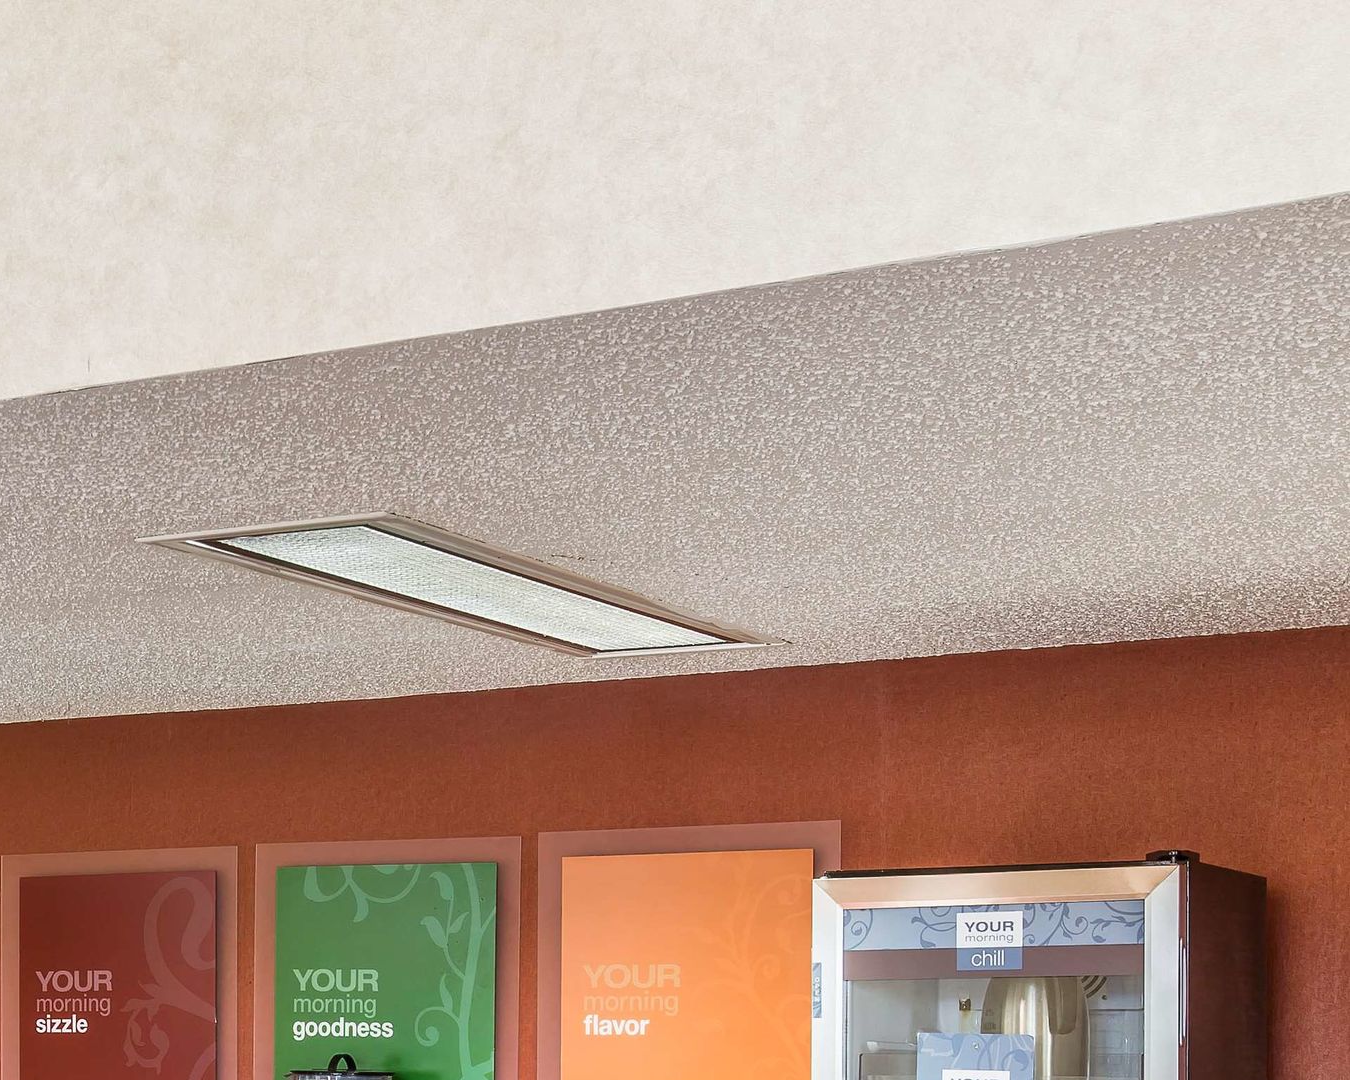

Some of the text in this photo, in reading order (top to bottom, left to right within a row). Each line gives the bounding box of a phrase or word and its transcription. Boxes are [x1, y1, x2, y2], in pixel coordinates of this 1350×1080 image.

[964, 920, 1014, 932] YOUR
[965, 934, 1014, 943] morning
[971, 949, 1004, 967] chill
[35, 970, 113, 992] YOUR
[293, 968, 379, 992] YOUR
[583, 963, 682, 989] YOUR
[36, 993, 111, 1017] morning
[293, 993, 377, 1018] morning
[583, 990, 679, 1017] morning
[35, 1014, 88, 1034] sizzle
[292, 1016, 394, 1041] goodness
[583, 1014, 650, 1036] flavor
